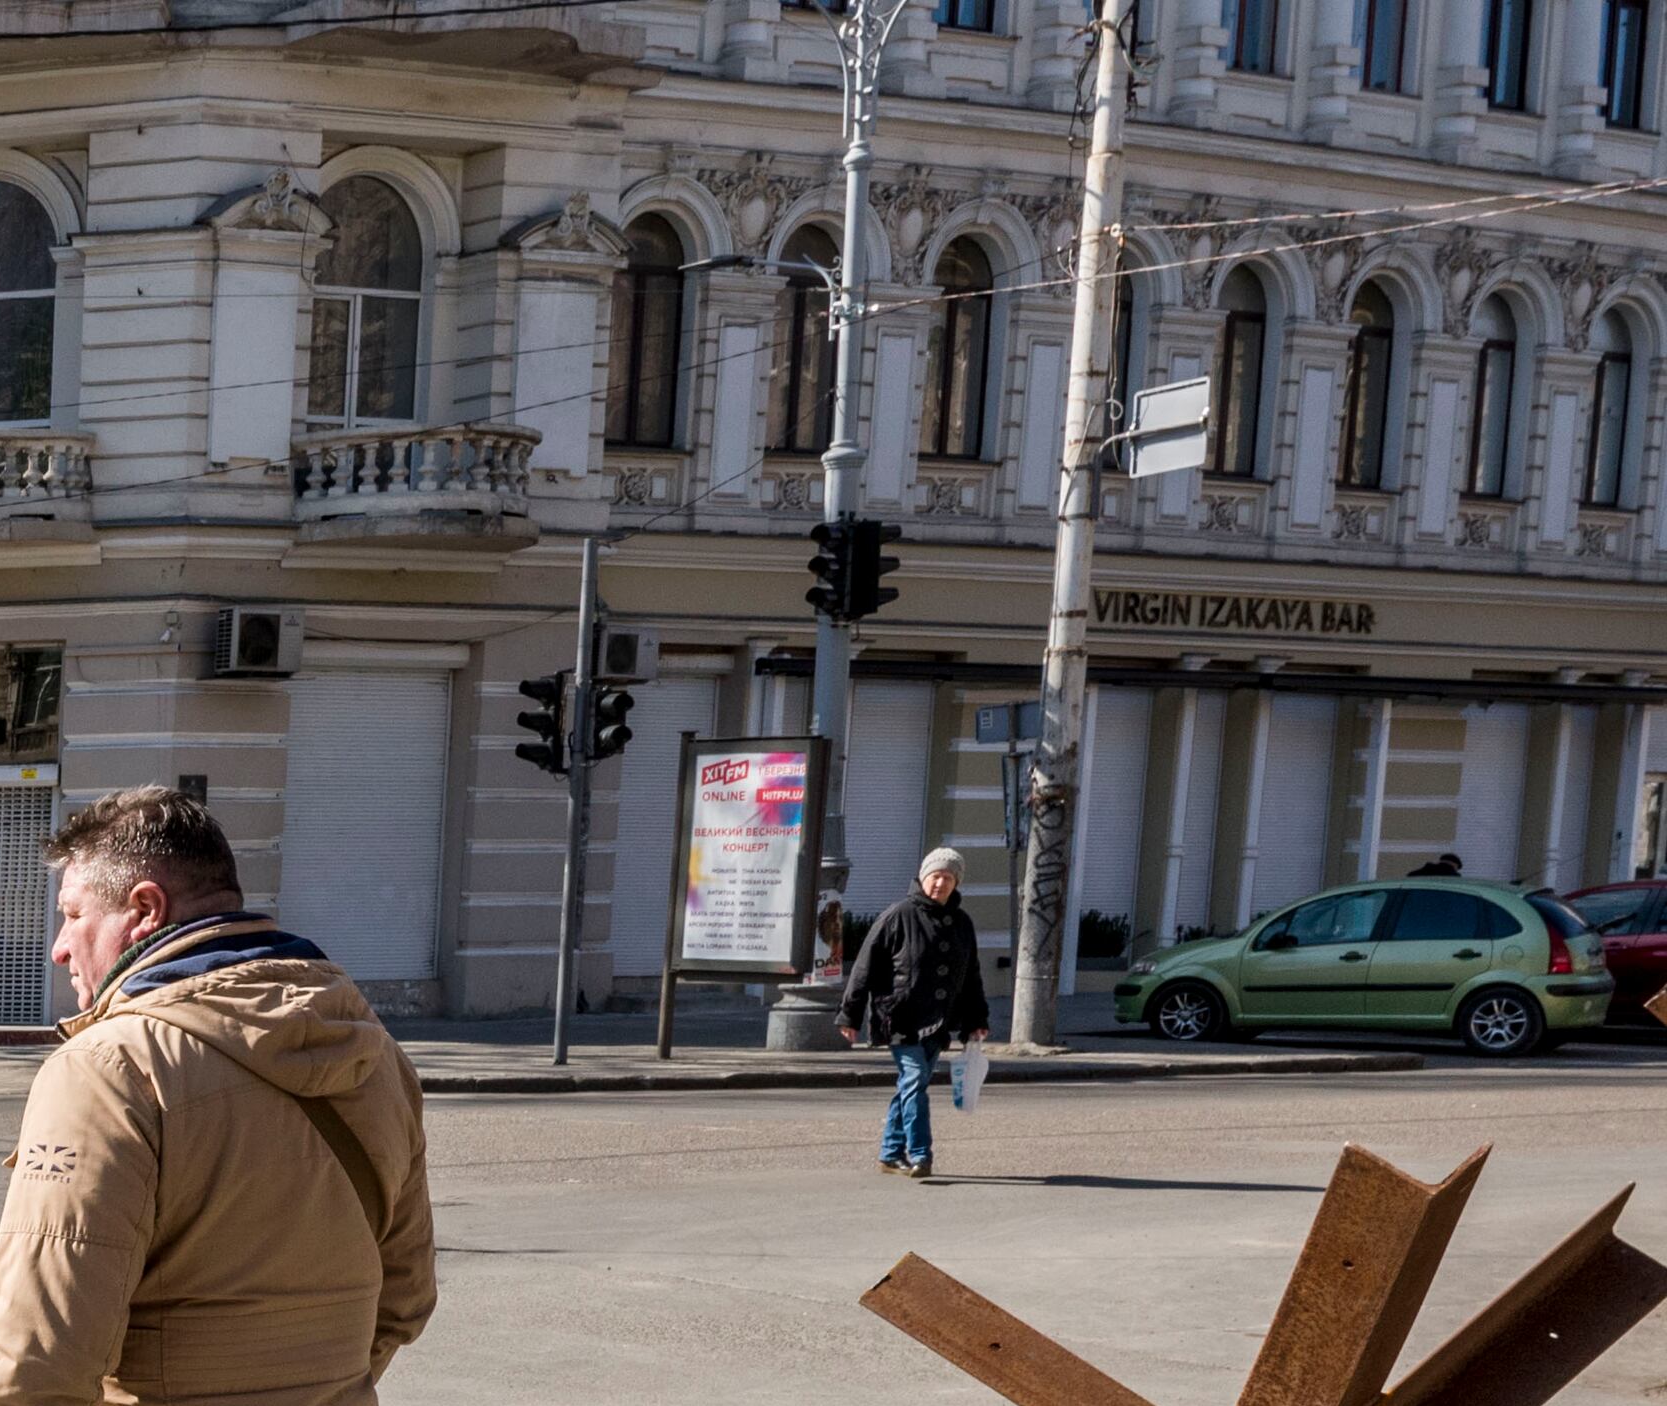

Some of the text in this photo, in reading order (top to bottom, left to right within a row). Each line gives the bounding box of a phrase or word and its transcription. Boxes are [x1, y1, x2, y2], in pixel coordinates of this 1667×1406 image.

[1094, 588, 1375, 635] VIRGIN IZAKAYA BAR
[702, 790, 747, 802] ONLINE
[694, 825, 743, 838] ВЕЛИКИЙ
[722, 842, 770, 854] КОНЦЕРТ
